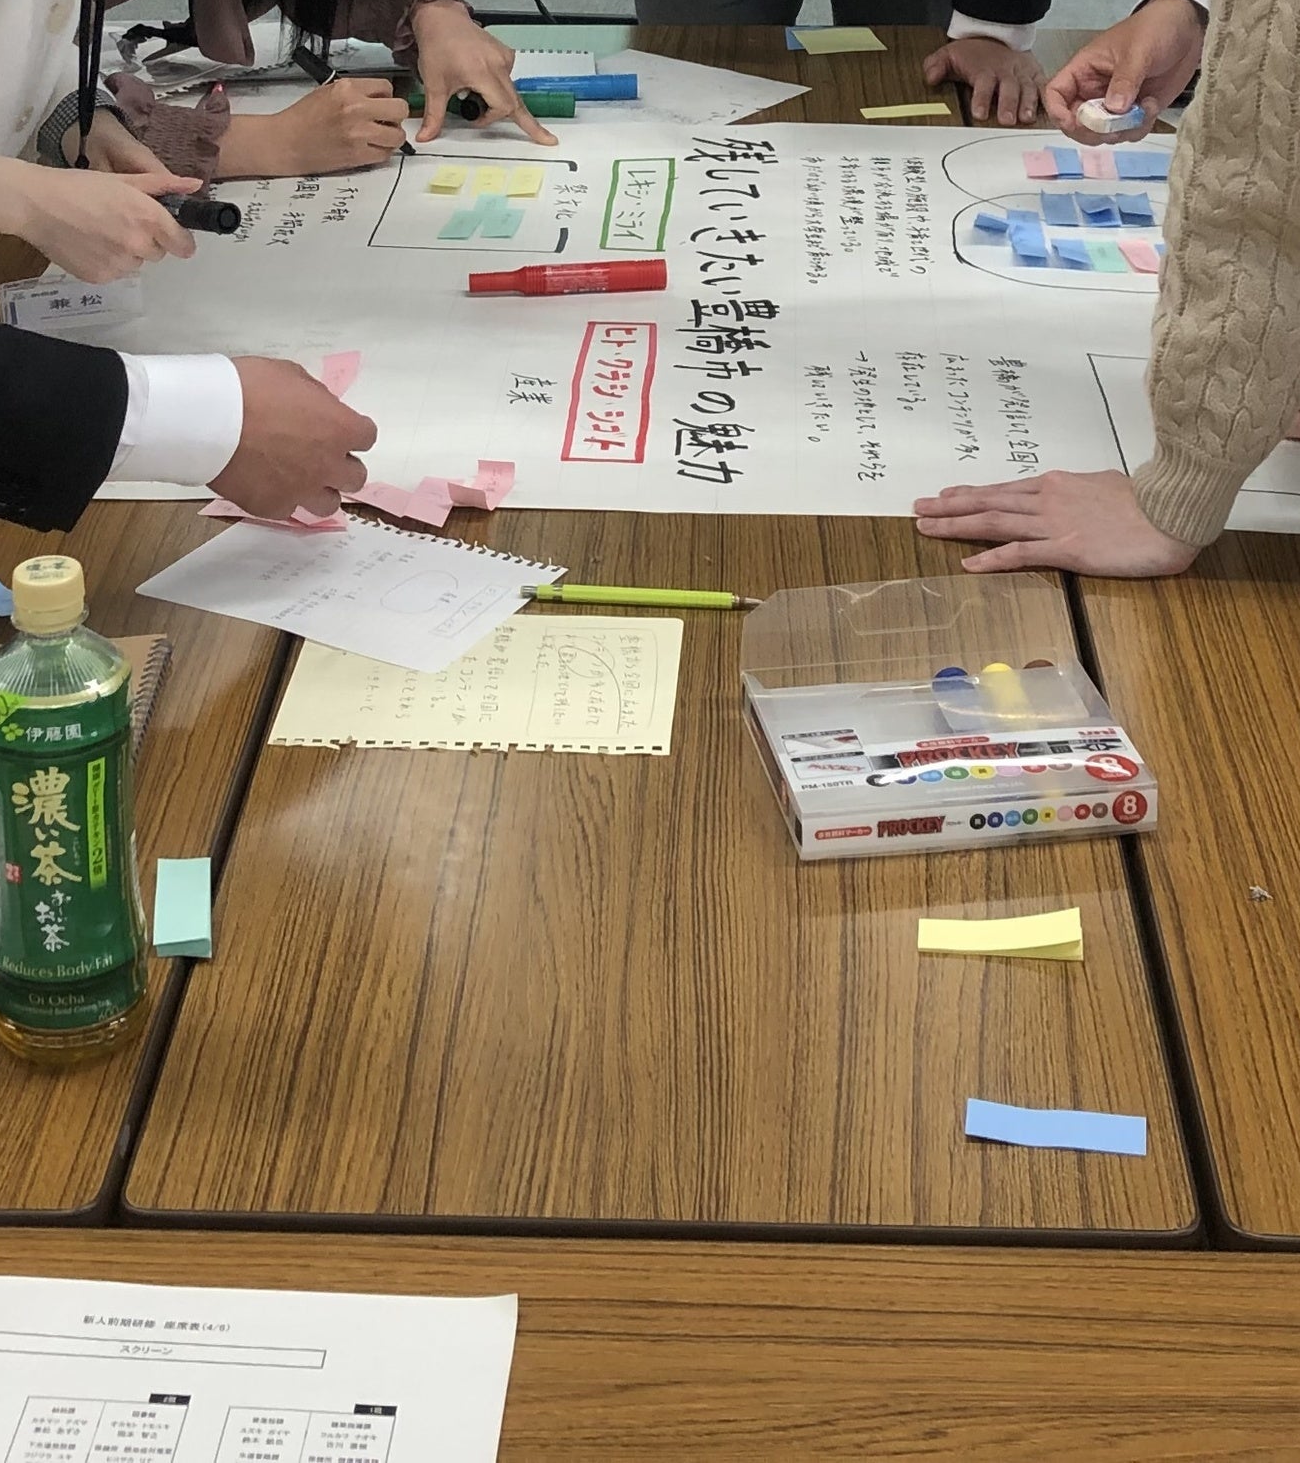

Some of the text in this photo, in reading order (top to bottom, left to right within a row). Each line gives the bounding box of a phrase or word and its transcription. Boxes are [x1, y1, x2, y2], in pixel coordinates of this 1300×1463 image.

[673, 137, 780, 484] 残していきたい豊橋市の魅力
[26, 723, 84, 742] 伊藤園
[896, 741, 1017, 769] PROCKEY
[1121, 794, 1139, 816] 8
[12, 767, 83, 886] 濃い茶
[877, 815, 946, 838] PROCKEY
[34, 901, 70, 952] お茶
[1, 954, 113, 978] Reduces Body Fat
[49, 993, 85, 1006] Ocha
[83, 1315, 156, 1330] 新人前期研修
[119, 1344, 174, 1356] スクリーン
